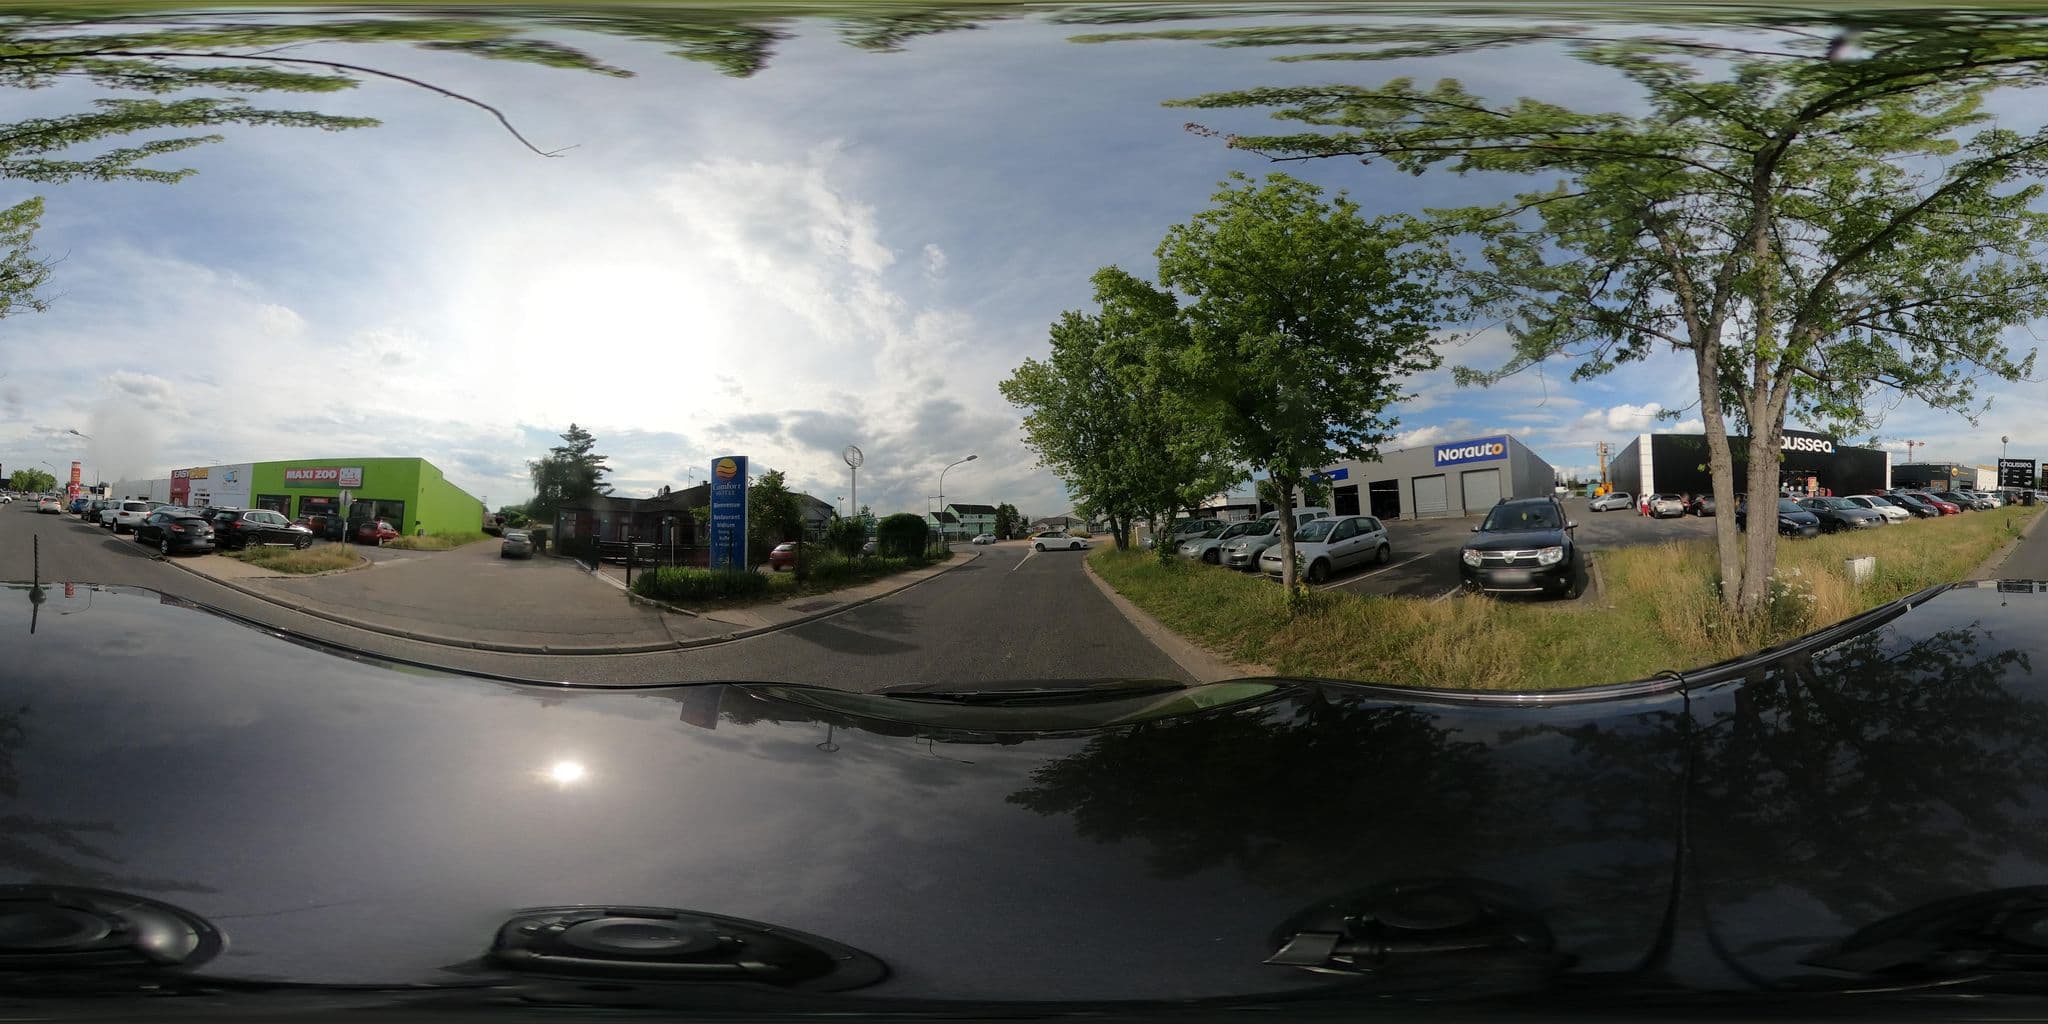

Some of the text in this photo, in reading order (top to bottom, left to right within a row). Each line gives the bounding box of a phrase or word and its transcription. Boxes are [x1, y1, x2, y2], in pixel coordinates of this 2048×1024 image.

[1438, 443, 1504, 461] Norauto
[286, 470, 313, 479] MAXI
[315, 470, 337, 479] ZOO
[713, 481, 741, 490] Comfort
